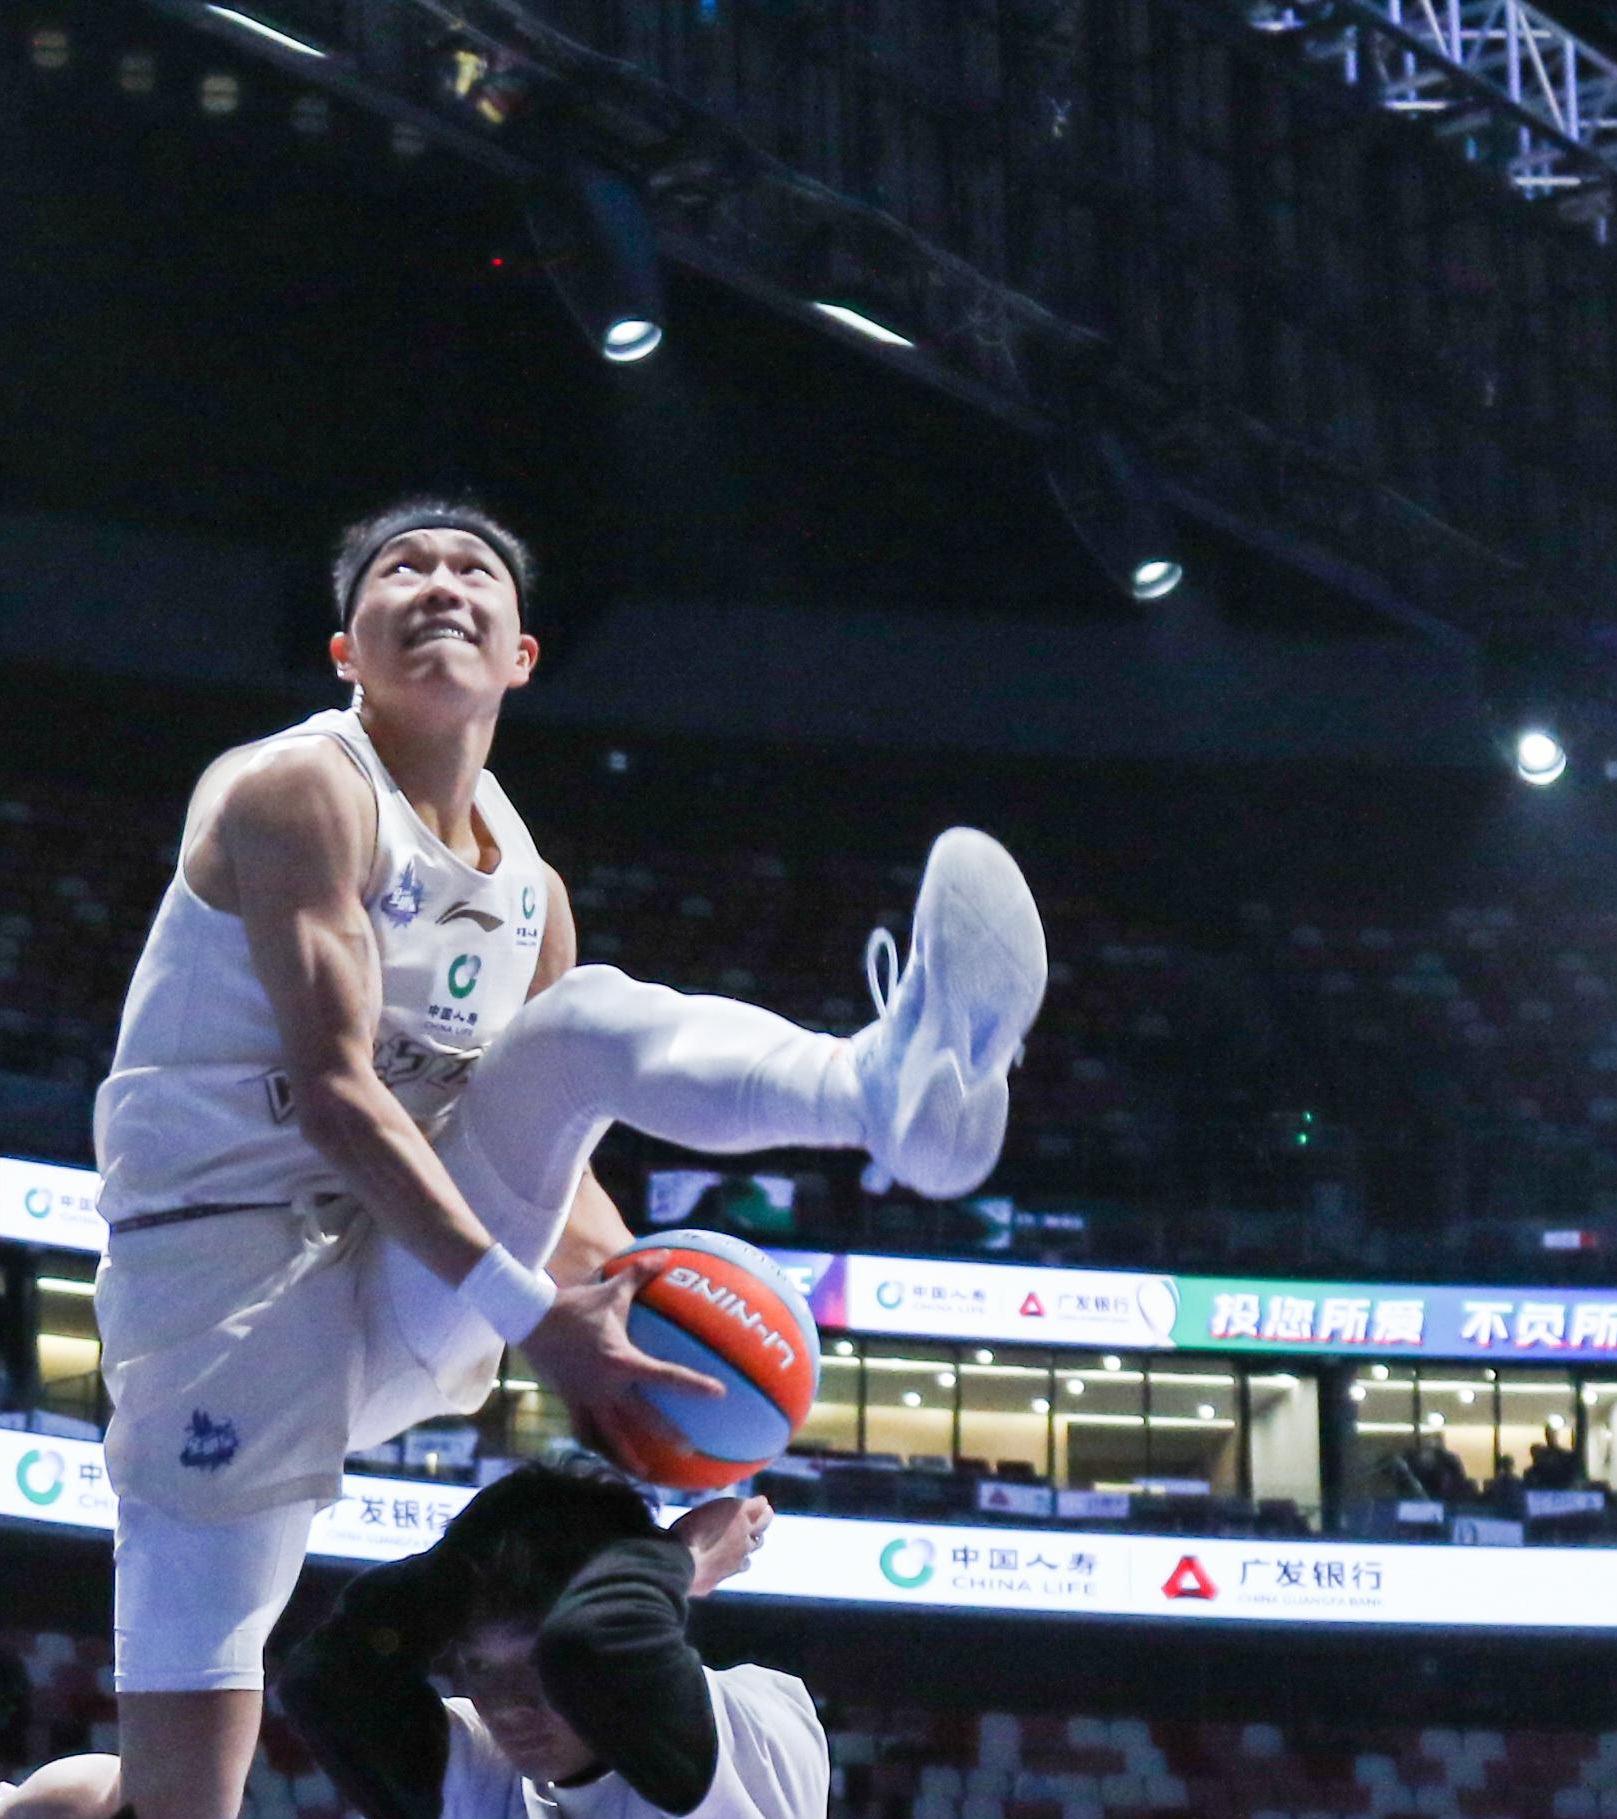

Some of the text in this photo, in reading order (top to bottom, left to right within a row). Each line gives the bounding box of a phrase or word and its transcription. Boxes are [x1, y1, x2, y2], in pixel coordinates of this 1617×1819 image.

[428, 1004, 479, 1026] 中国人寿
[913, 1285, 987, 1301] 中国人寿
[1058, 1293, 1130, 1314] 广发银行
[664, 1266, 796, 1371] LI-NING
[1210, 1293, 1425, 1346] 投您所爱
[951, 1546, 1097, 1577] 中国人寿
[951, 1576, 1096, 1596] CHINA LIFE
[1240, 1559, 1383, 1591] 广发银行
